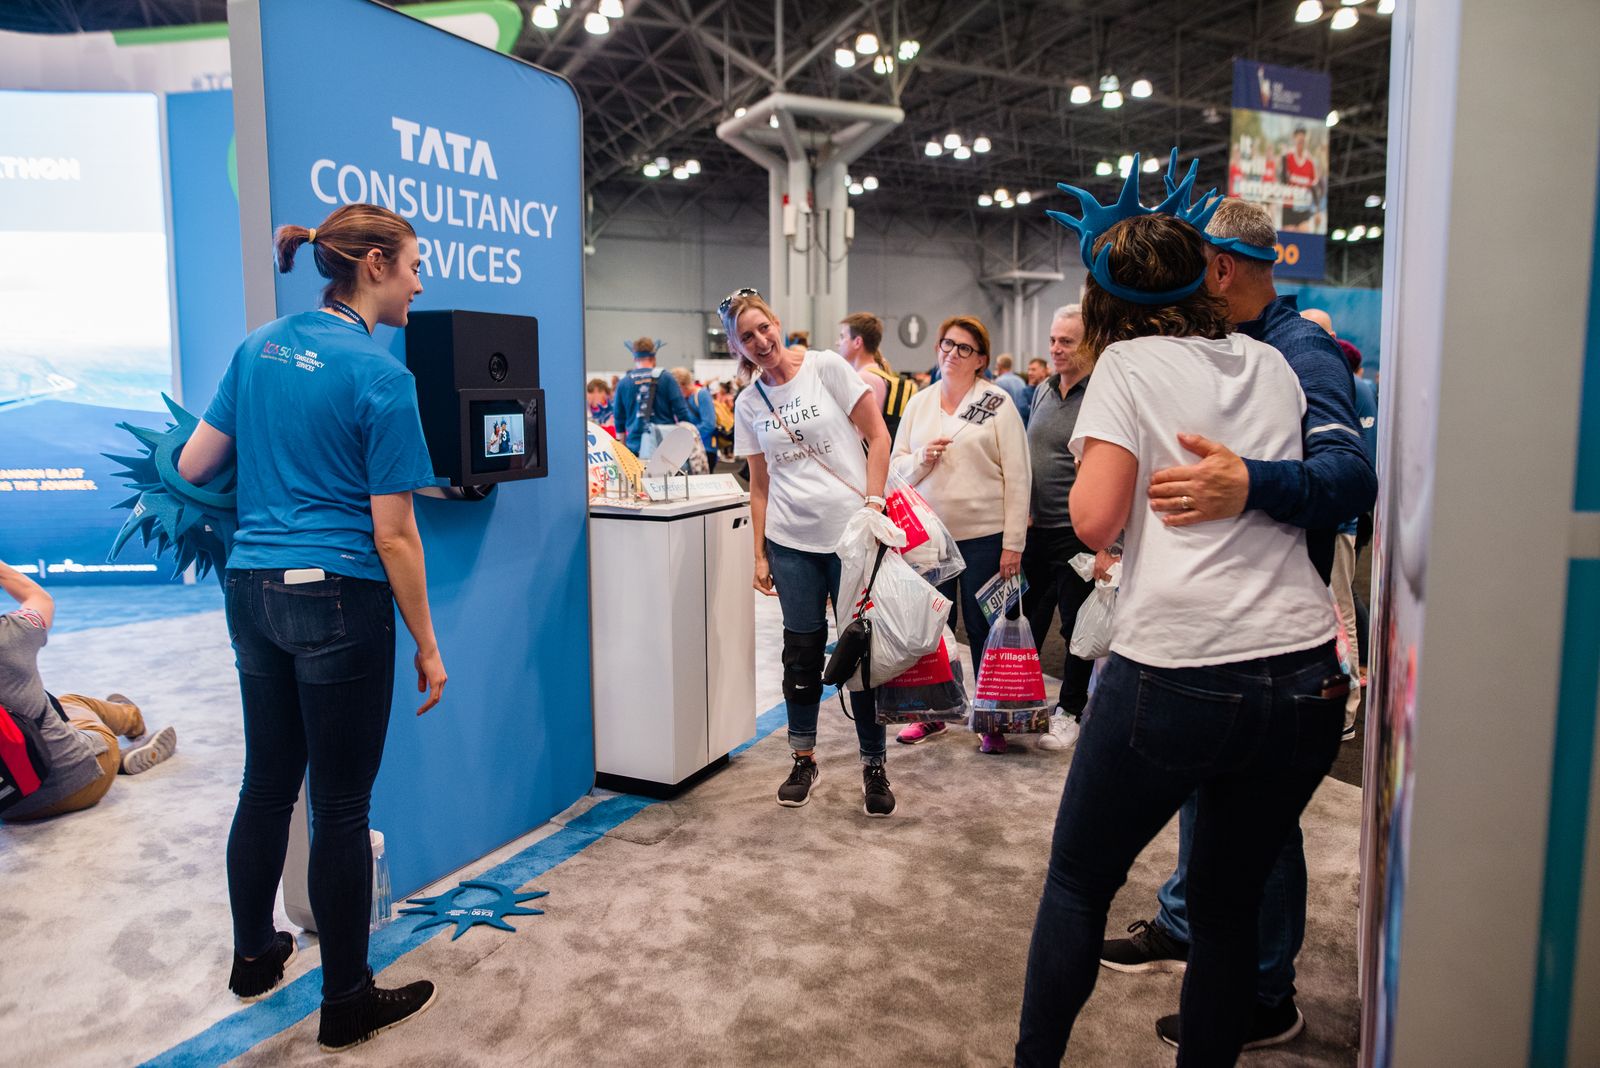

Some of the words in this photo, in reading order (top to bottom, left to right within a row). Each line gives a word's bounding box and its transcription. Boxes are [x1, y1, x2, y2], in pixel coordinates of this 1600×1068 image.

[391, 116, 498, 181] TATA
[0, 156, 80, 181] THON
[310, 158, 558, 239] CONSULTANCY
[416, 237, 522, 285] RVICES
[778, 396, 801, 414] THE
[764, 404, 820, 432] FUTURE
[587, 450, 613, 464] ATA
[774, 441, 832, 463] FEMALE
[1000, 652, 1026, 662] Village
